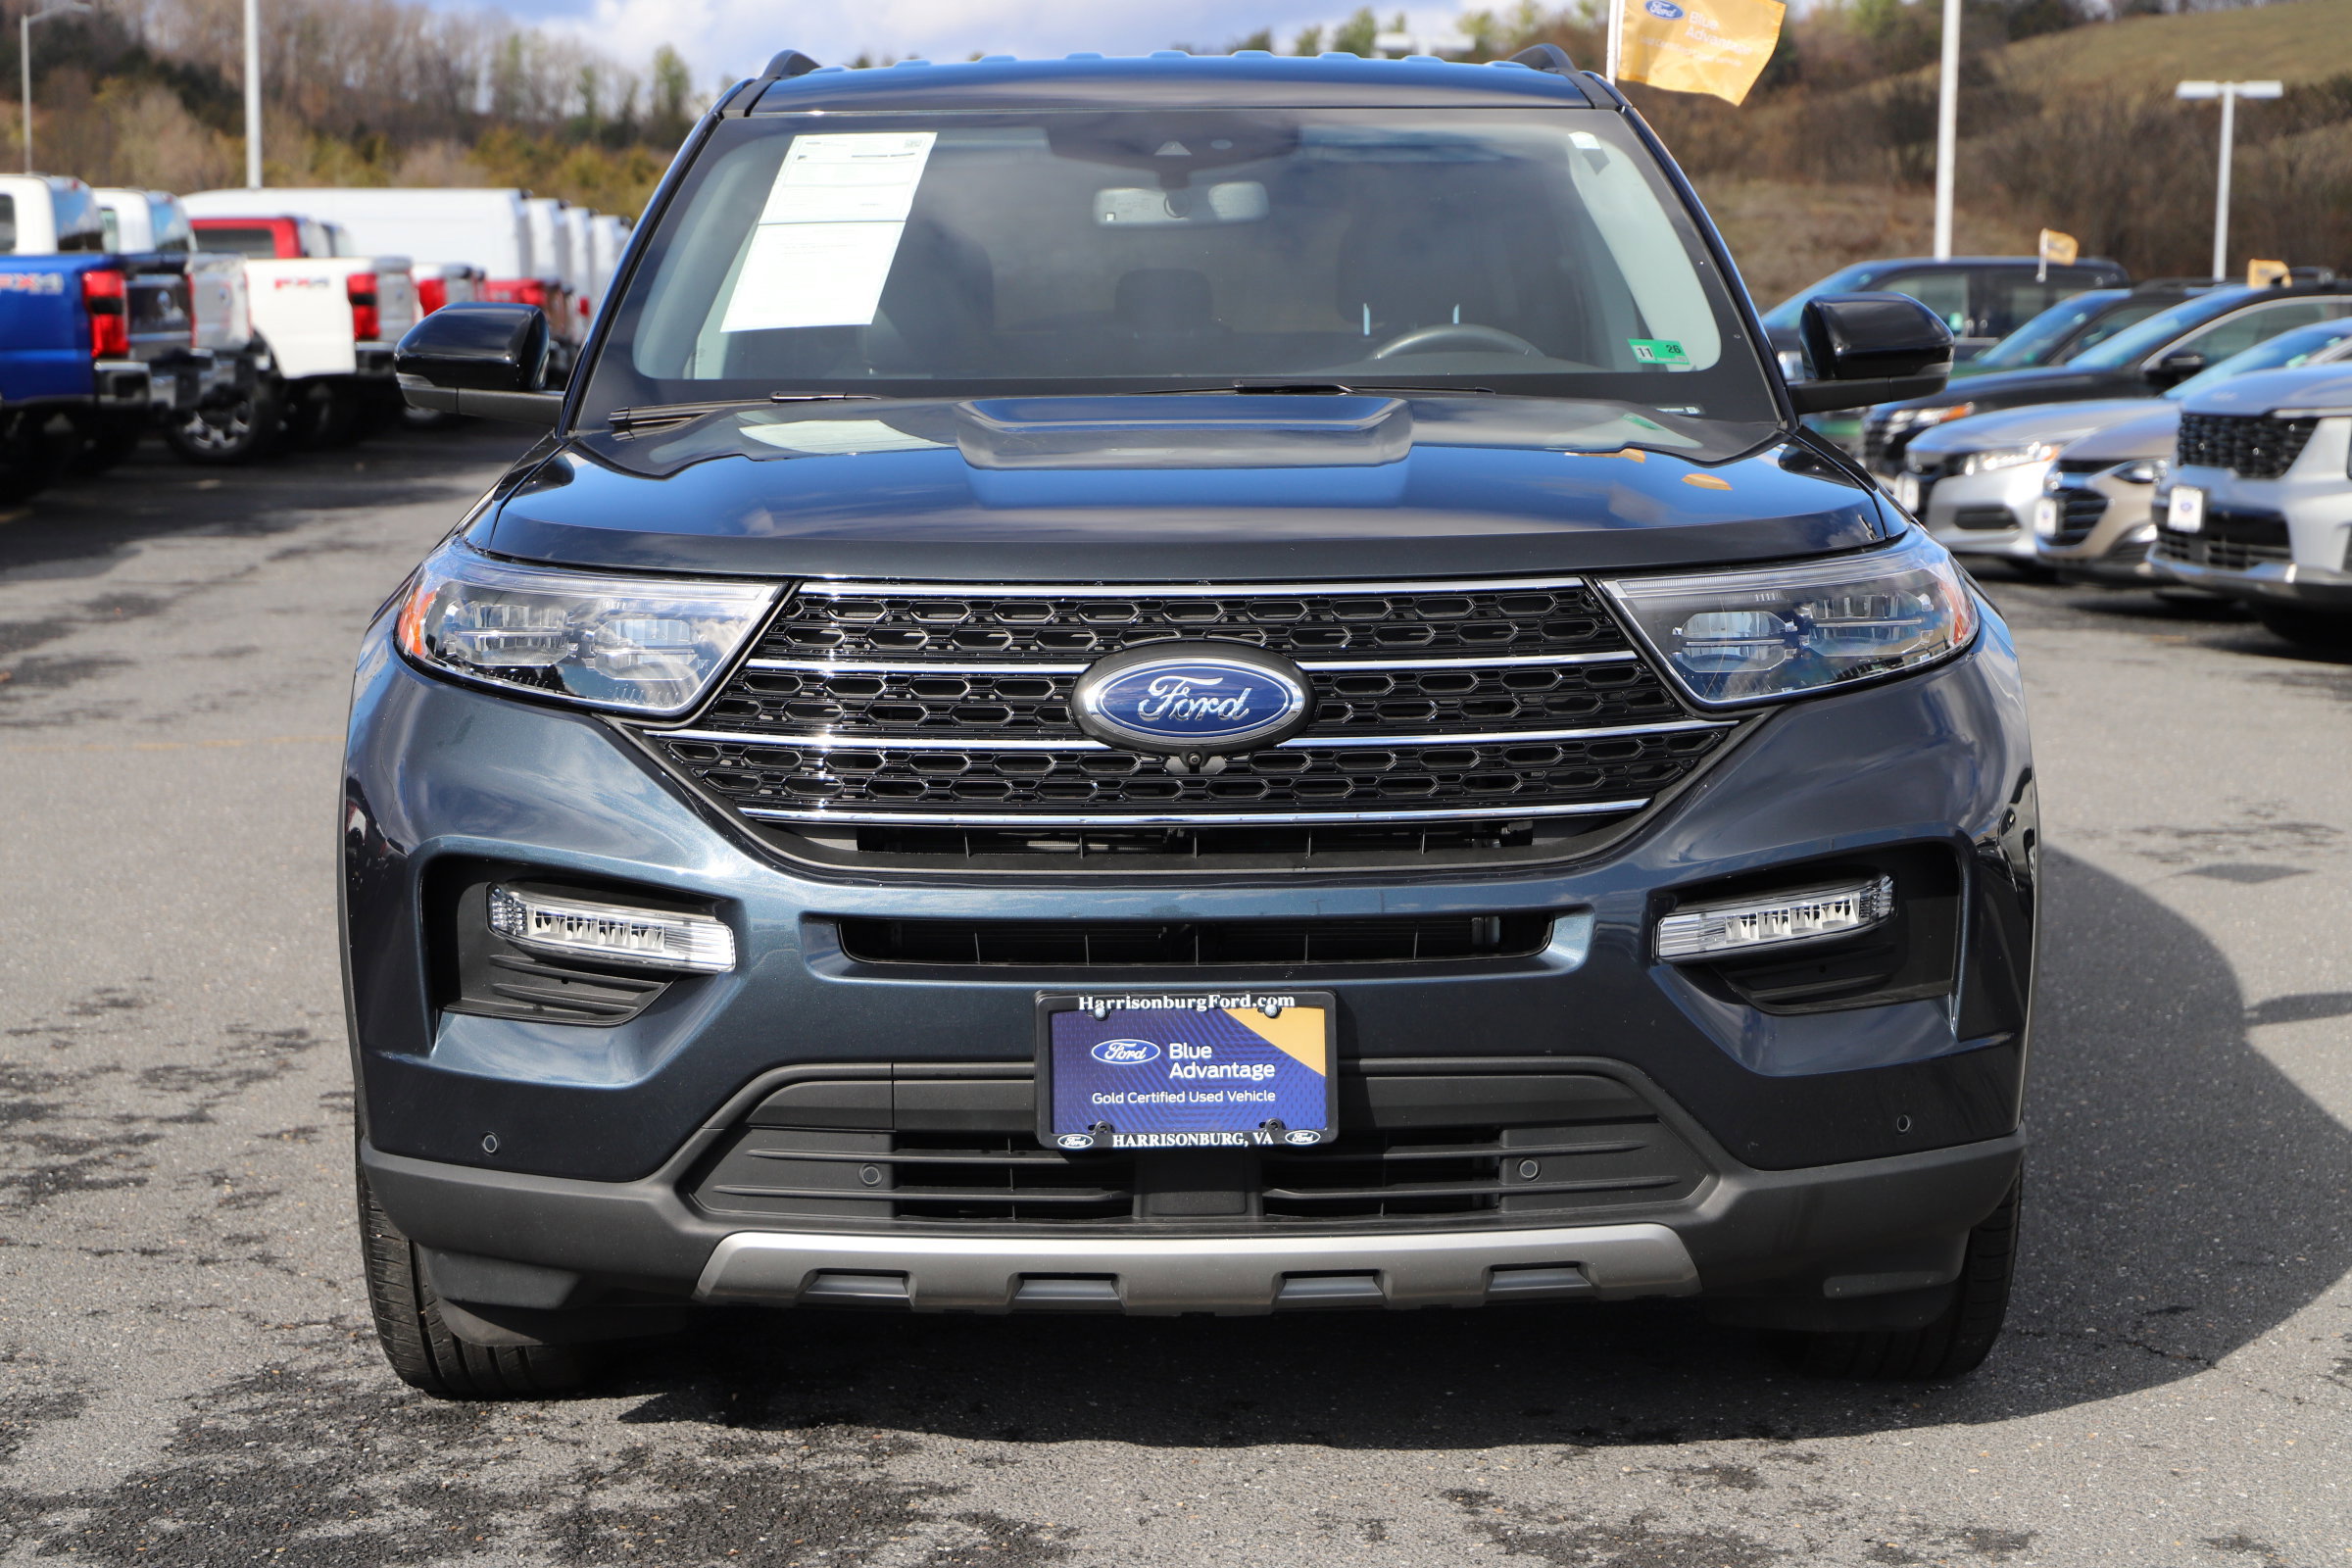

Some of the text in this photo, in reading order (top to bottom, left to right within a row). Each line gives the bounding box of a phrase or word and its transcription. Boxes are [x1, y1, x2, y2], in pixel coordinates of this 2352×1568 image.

[1649, 1, 1677, 18] Ford
[1689, 11, 1719, 30] Blue
[1638, 347, 1653, 358] 11
[1666, 344, 1682, 354] 26
[1137, 675, 1252, 721] Ford
[1078, 994, 1296, 1012] HarrisonburgFord.com
[1104, 1042, 1147, 1060] Ford
[1169, 1043, 1212, 1059] Blue
[1169, 1061, 1275, 1081] Advantage
[1092, 1090, 1276, 1104] Gold Certified Used Vehicle
[1064, 1135, 1087, 1147] Ford
[1112, 1132, 1274, 1148] HARRISONBURG, VA
[1293, 1131, 1313, 1143] Ford
